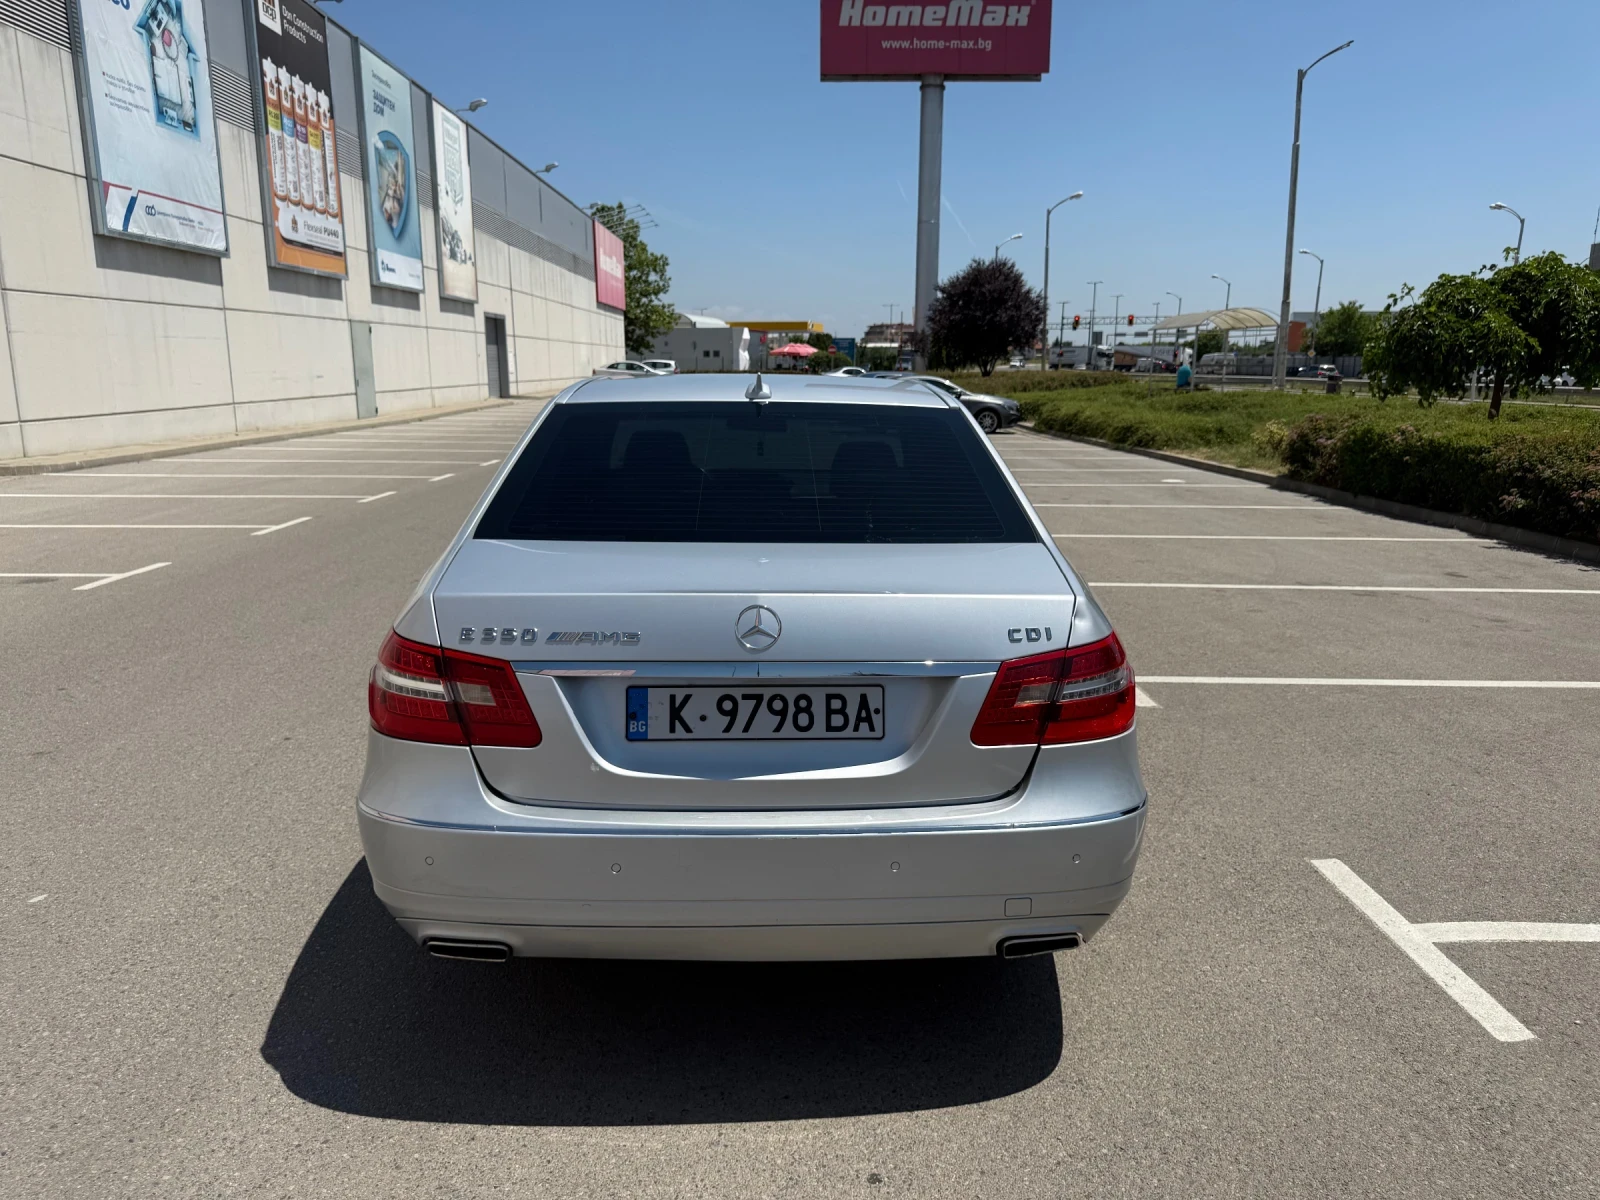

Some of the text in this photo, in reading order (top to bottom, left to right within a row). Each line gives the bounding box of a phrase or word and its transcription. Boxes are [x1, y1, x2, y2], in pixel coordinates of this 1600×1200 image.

[839, 0, 1030, 27] HomeMax
[282, 5, 324, 44] Don Construction
[283, 19, 307, 44] Products
[881, 38, 992, 51] www.home-max.bg
[461, 627, 640, 643] E 350 AMG
[1008, 627, 1052, 643] CDI
[669, 693, 876, 734] K 9798 BA
[629, 721, 646, 733] BG
